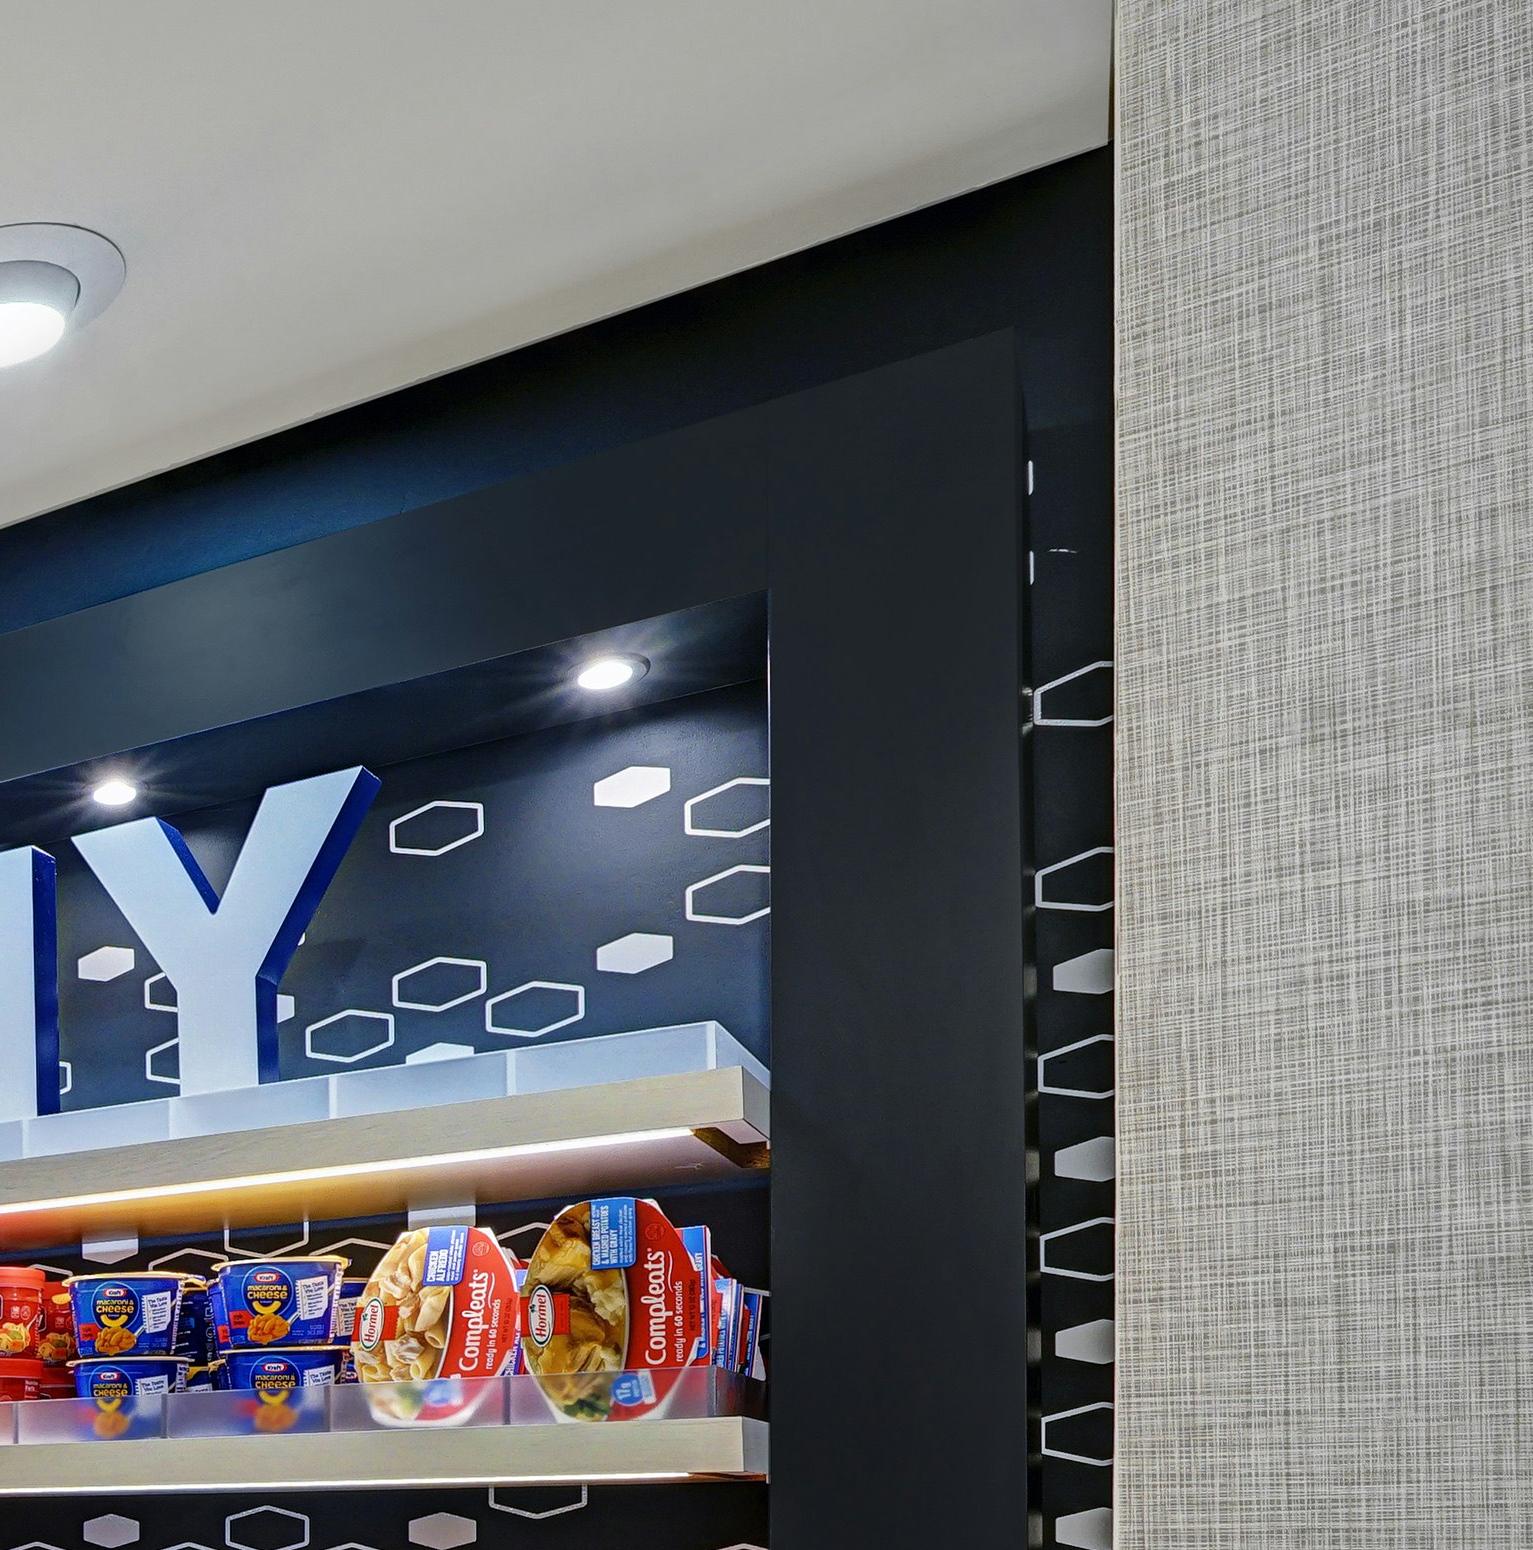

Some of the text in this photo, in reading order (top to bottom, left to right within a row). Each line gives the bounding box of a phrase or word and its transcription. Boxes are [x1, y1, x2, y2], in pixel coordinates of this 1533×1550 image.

[601, 1205, 609, 1234] POTATOES
[592, 1218, 601, 1266] CHICKEN BREAST
[601, 1234, 610, 1258] MASHED
[610, 1229, 618, 1264] WITH GRAVY
[258, 1273, 275, 1281] Kraft
[427, 1250, 439, 1283] CHICKEN
[435, 1249, 449, 1282] ALFREDO
[106, 1288, 124, 1296] Kraft
[247, 1285, 282, 1293] macaroni
[364, 1303, 379, 1343] Hormel
[459, 1271, 489, 1372] Compleats
[535, 1293, 548, 1338] Hormel
[641, 1251, 673, 1366] Compleats
[674, 1281, 685, 1363] ready in 60 seconds
[486, 1299, 502, 1370] ready in 60 seconds
[101, 1372, 118, 1380] Kraft
[255, 1374, 290, 1382] macaroni
[265, 1364, 284, 1372] Kraft
